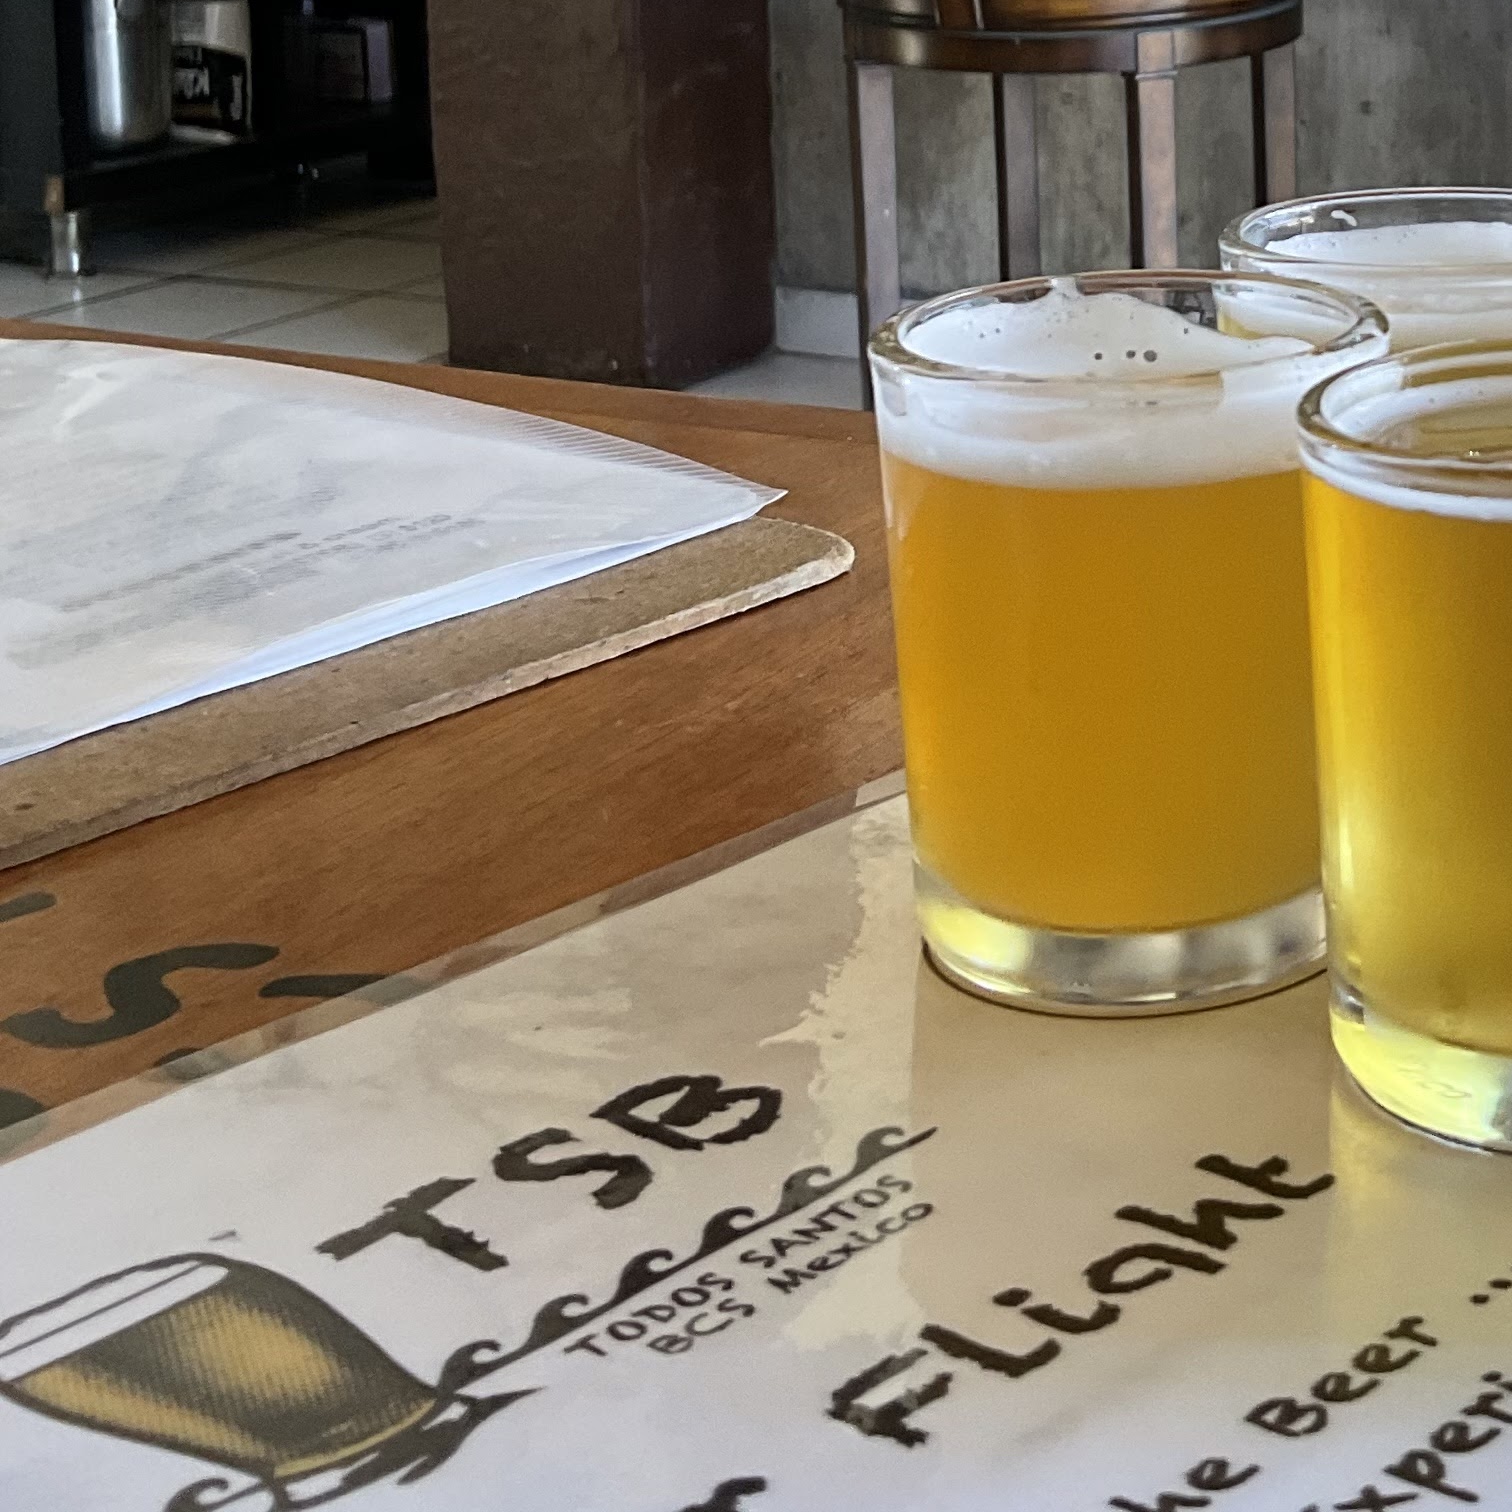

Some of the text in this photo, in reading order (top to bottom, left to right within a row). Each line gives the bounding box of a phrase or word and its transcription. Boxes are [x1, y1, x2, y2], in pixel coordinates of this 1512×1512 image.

[314, 1075, 782, 1272] TSB
[564, 1174, 914, 1359] TODOS SANTOS
[647, 1201, 934, 1354] BCS Mexico
[1245, 1315, 1437, 1437] Beer
